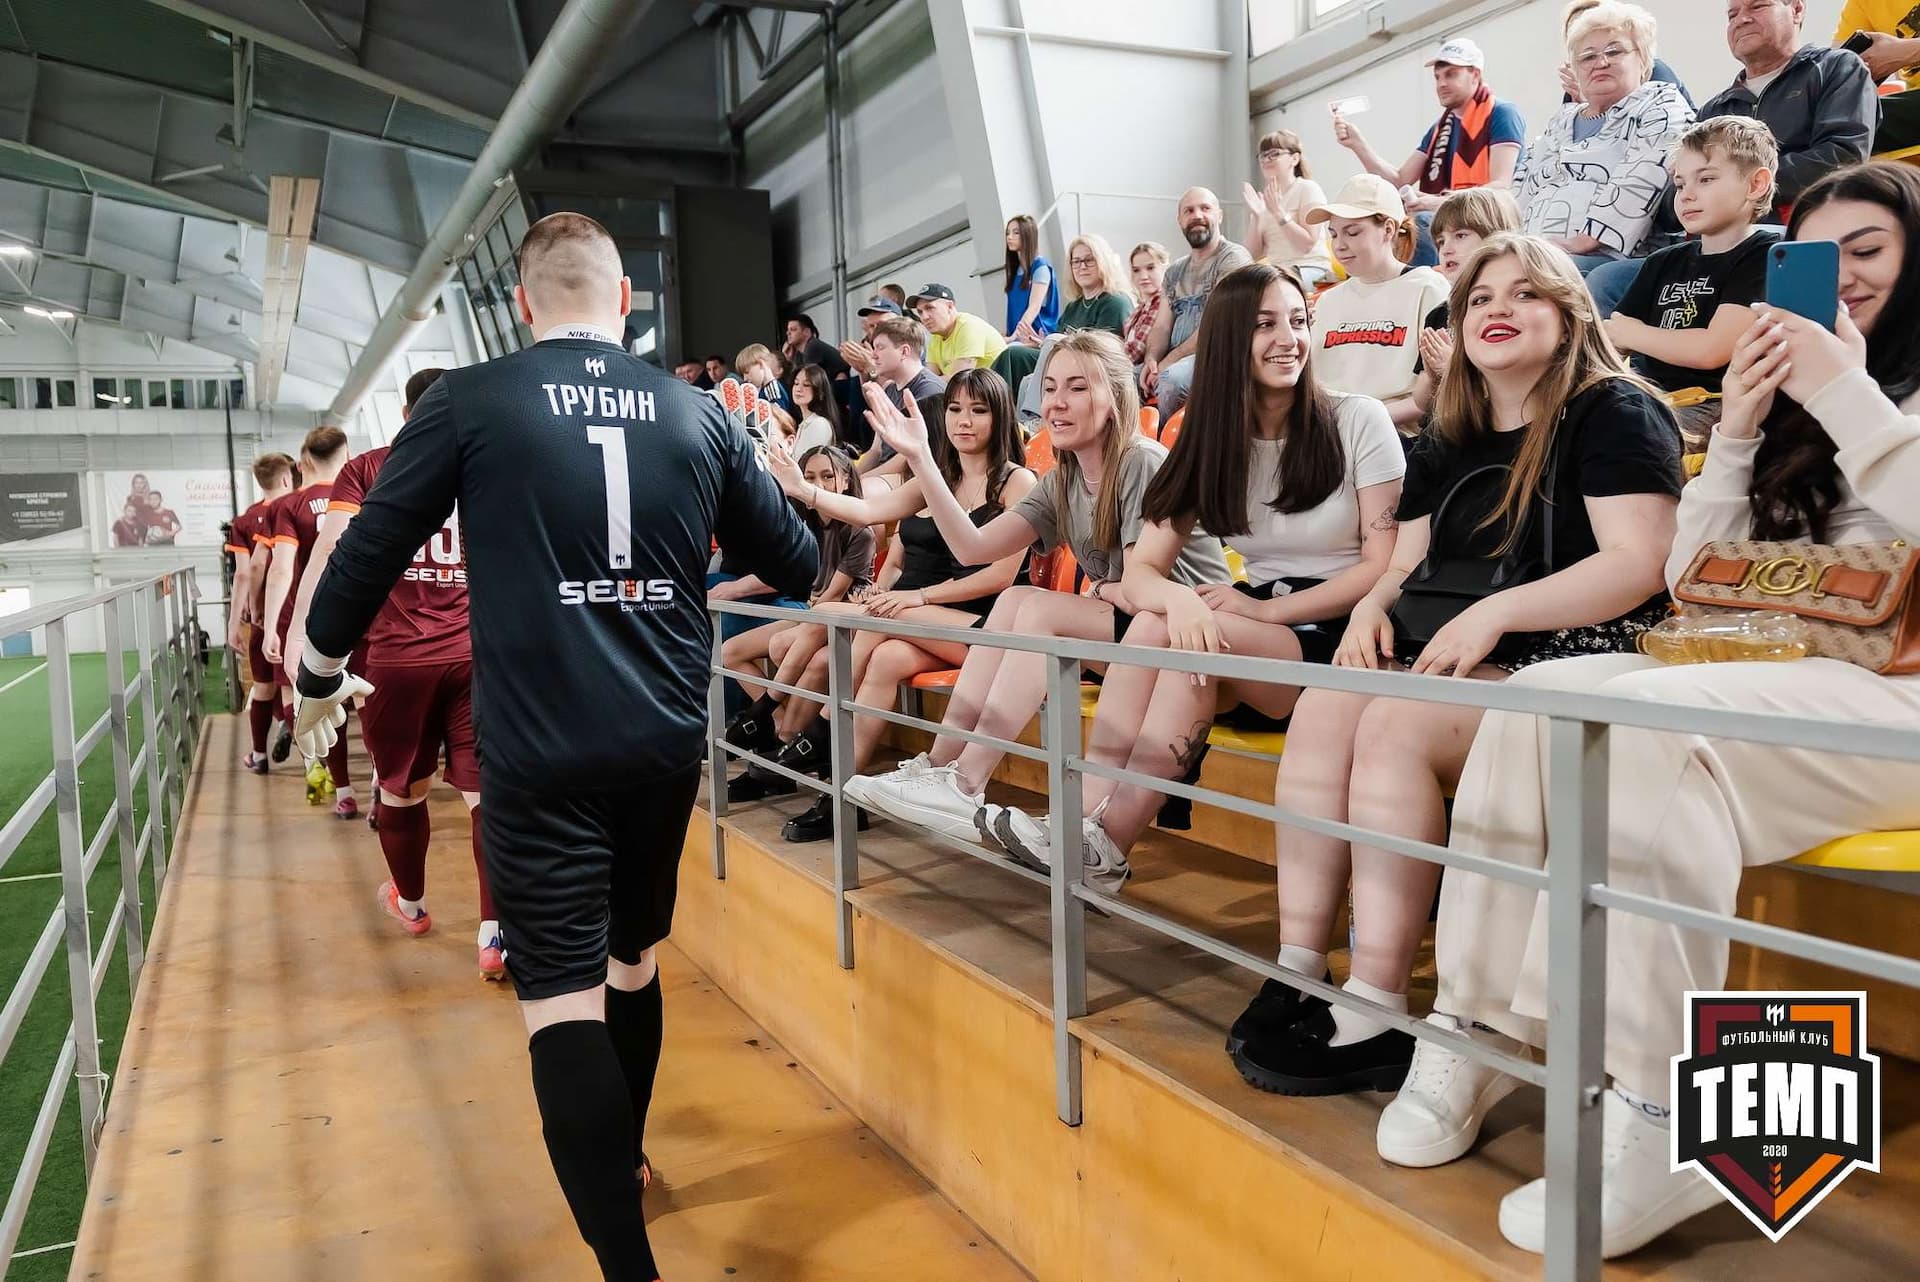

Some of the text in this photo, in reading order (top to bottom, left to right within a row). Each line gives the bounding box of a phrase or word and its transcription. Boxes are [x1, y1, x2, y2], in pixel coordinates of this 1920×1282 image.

[1323, 326, 1408, 349] DEPRESSION
[1337, 320, 1395, 332] CRIPPLING
[541, 383, 656, 421] ТРУБИН
[586, 425, 632, 569] 1
[402, 566, 468, 583] SEUS
[558, 579, 674, 605] SEUS
[649, 601, 675, 611] Union
